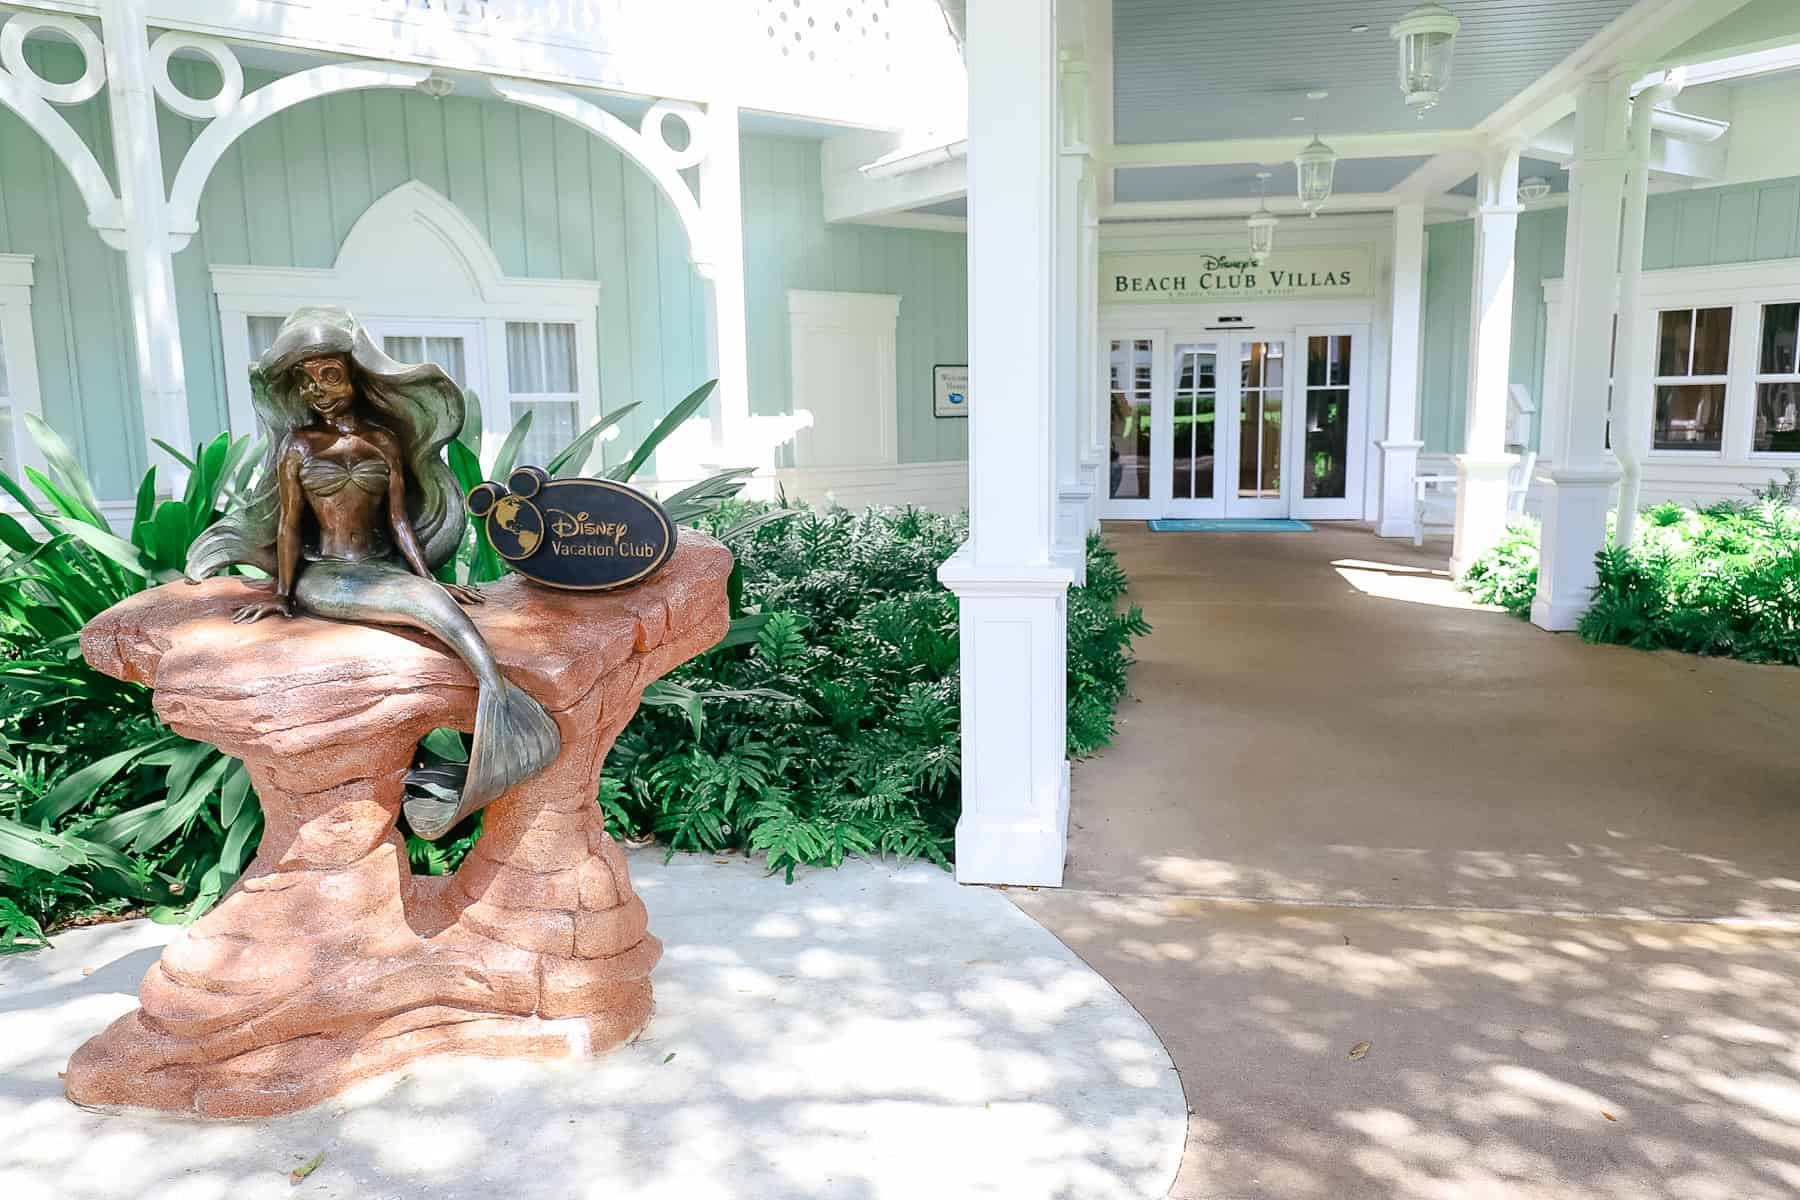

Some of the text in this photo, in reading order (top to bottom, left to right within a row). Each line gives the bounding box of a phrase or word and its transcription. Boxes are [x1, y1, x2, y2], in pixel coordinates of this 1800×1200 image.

[1115, 276, 1186, 292] BEACH
[1200, 273, 1257, 289] CLUB
[1270, 271, 1351, 288] VILLAS
[551, 540, 654, 557] Vacation Club
